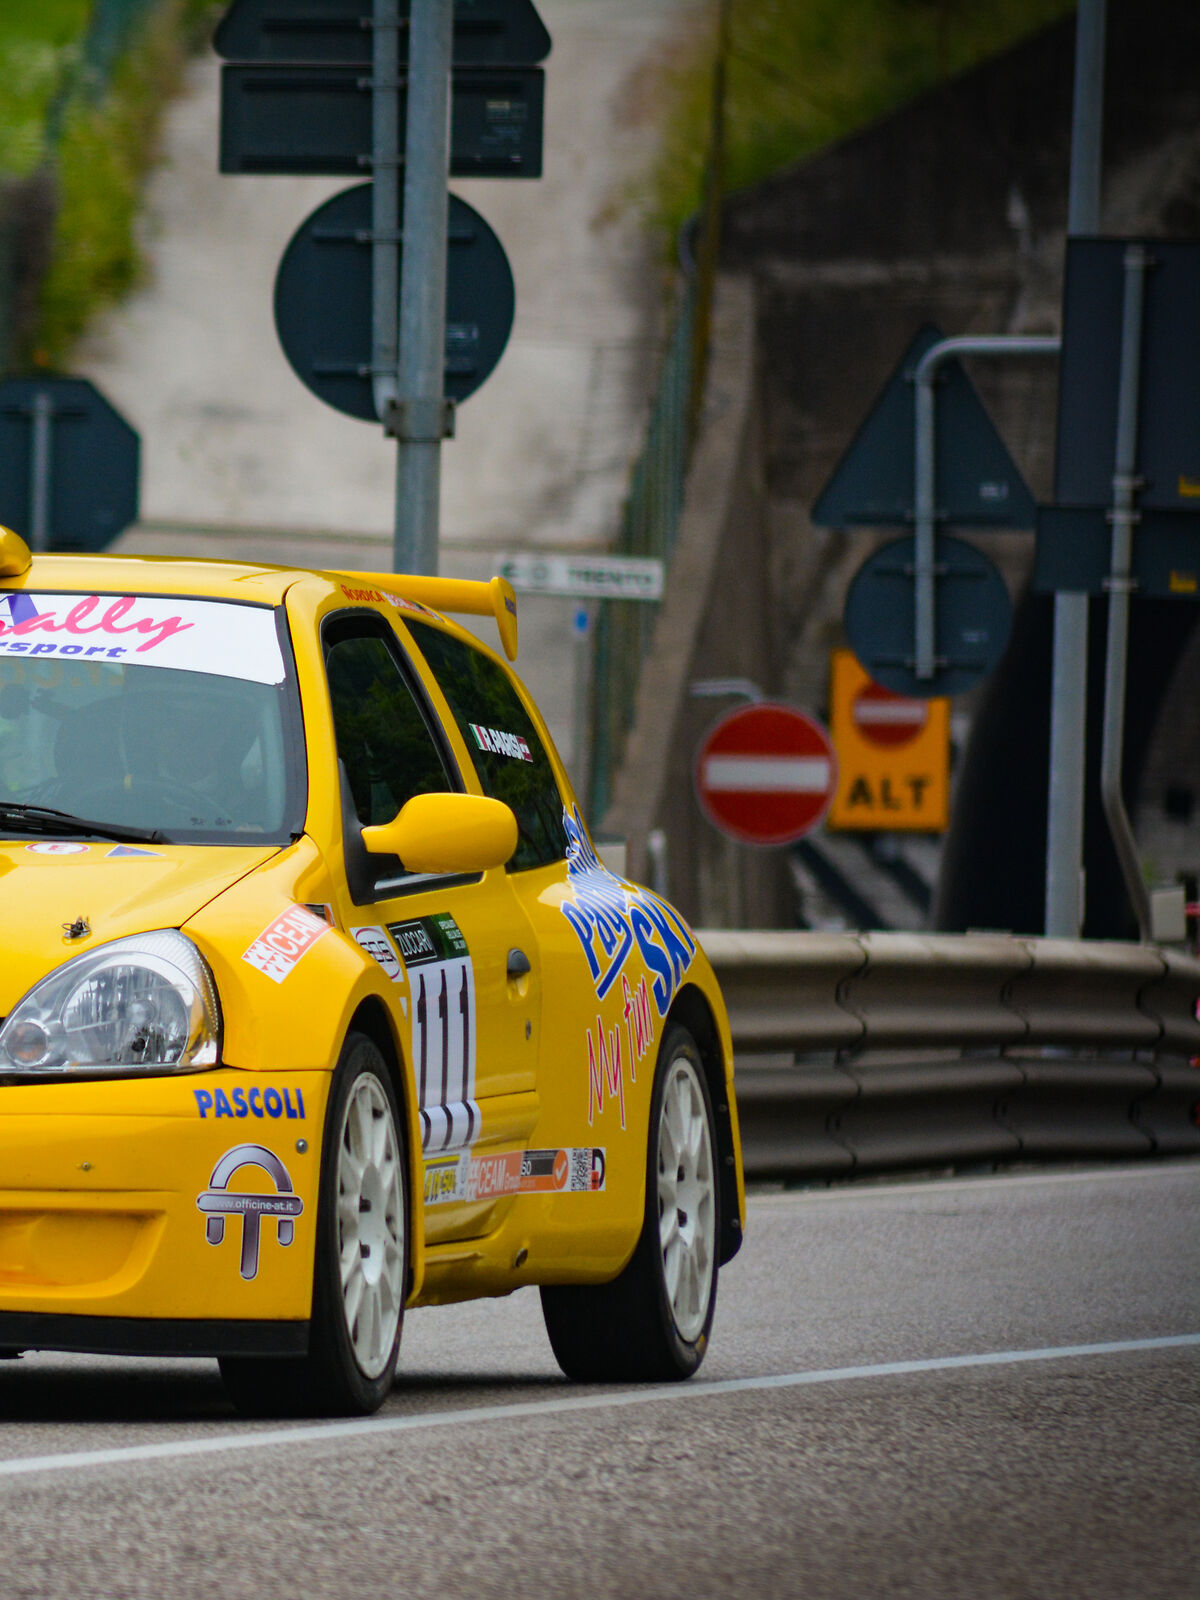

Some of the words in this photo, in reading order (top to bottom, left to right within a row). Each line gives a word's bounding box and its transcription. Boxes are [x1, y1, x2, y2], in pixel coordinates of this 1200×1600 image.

[845, 773, 934, 810] ALT
[629, 884, 697, 1018] SKI
[417, 964, 475, 1152] 111
[193, 1086, 306, 1120] PASCOLI
